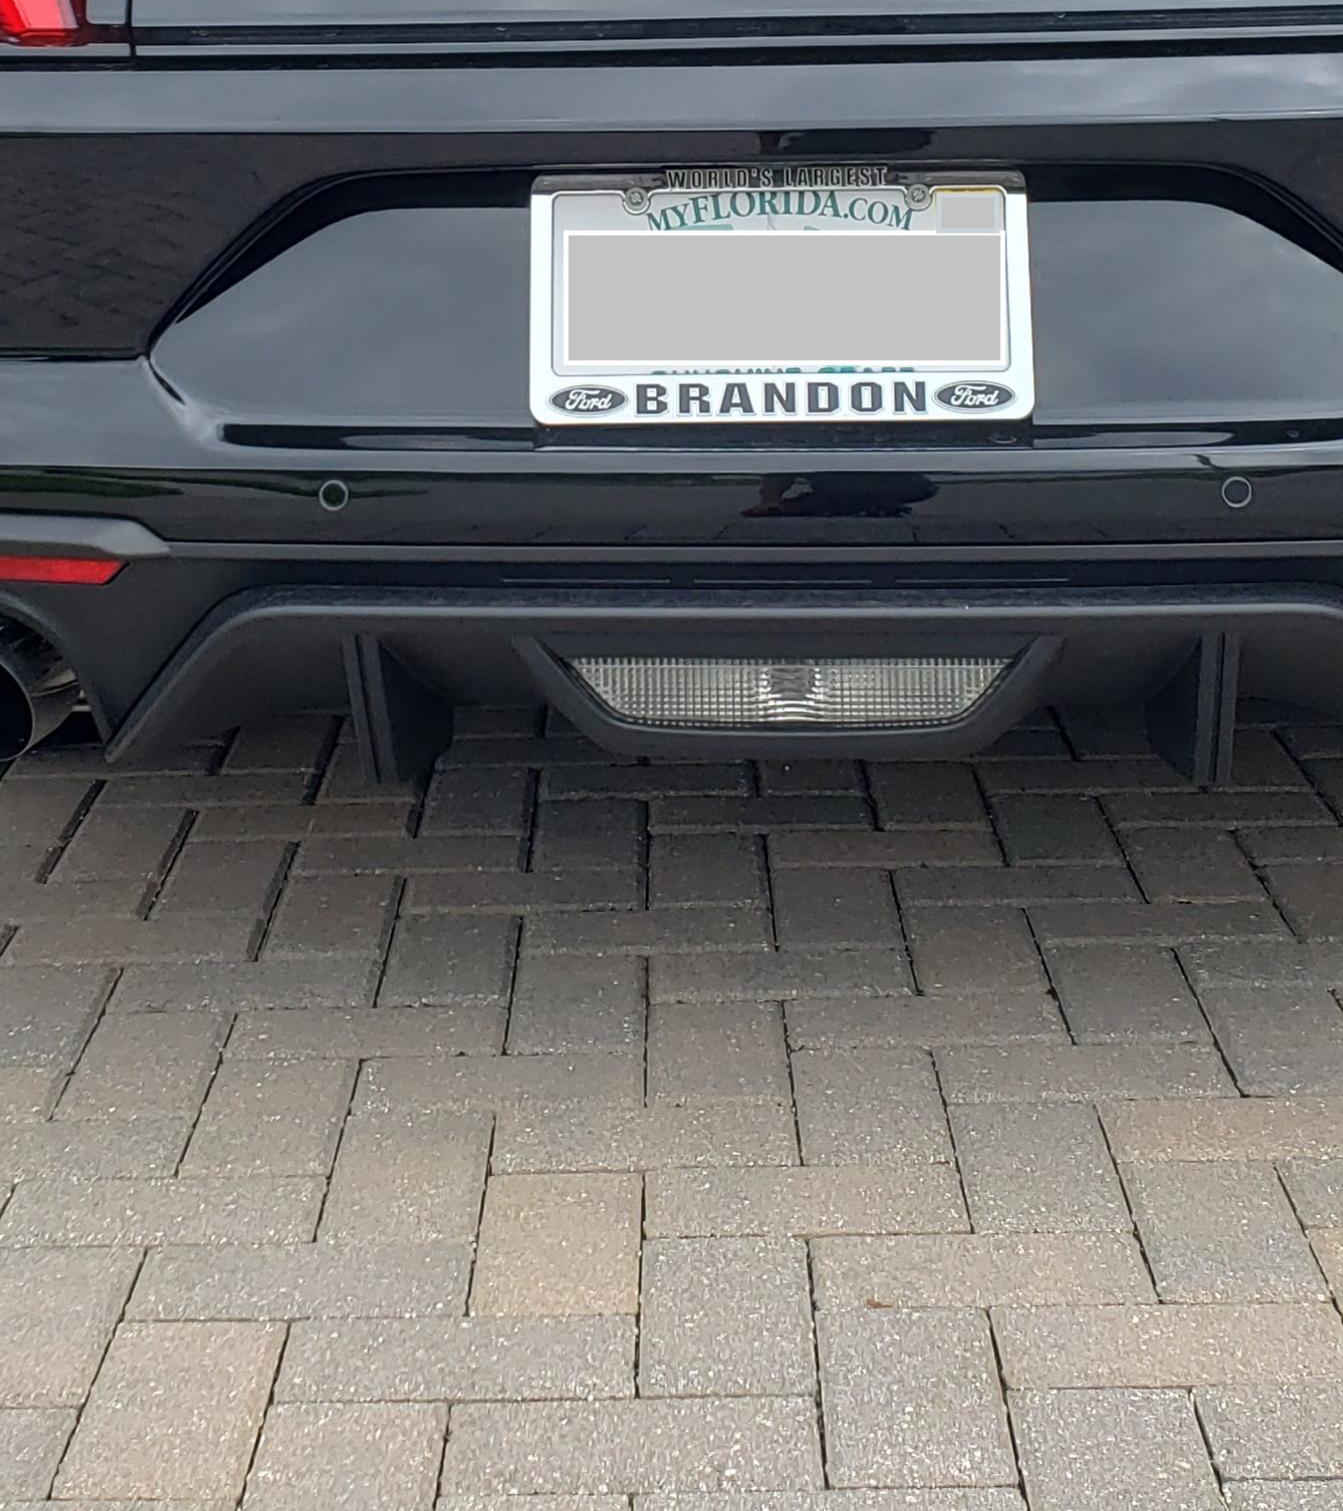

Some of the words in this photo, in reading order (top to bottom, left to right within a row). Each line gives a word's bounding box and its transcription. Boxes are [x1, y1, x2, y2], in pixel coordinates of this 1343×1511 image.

[666, 168, 773, 189] WORLD'S
[784, 166, 889, 187] LARGEST
[647, 189, 913, 231] MYFLORIDA.COM
[564, 389, 612, 411] Ford
[634, 380, 927, 416] BRANDON
[950, 386, 1000, 408] Ford
